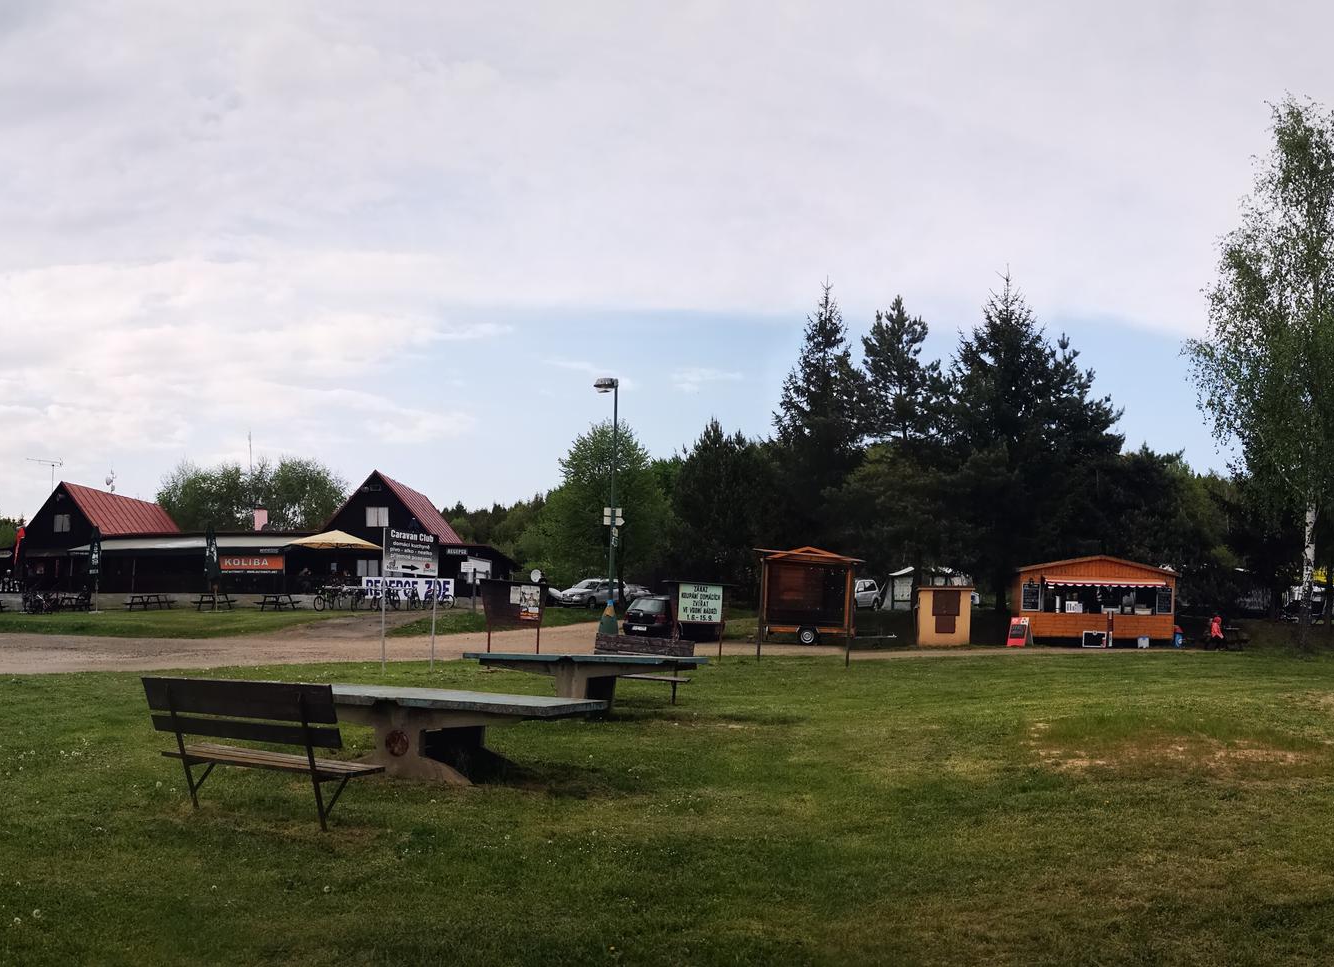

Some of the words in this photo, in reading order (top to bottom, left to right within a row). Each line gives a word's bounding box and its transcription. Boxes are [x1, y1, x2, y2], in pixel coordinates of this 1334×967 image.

[390, 529, 418, 541] Caravan
[419, 533, 434, 543] Club
[224, 558, 269, 566] KOLIBA
[424, 580, 451, 600] ZDE
